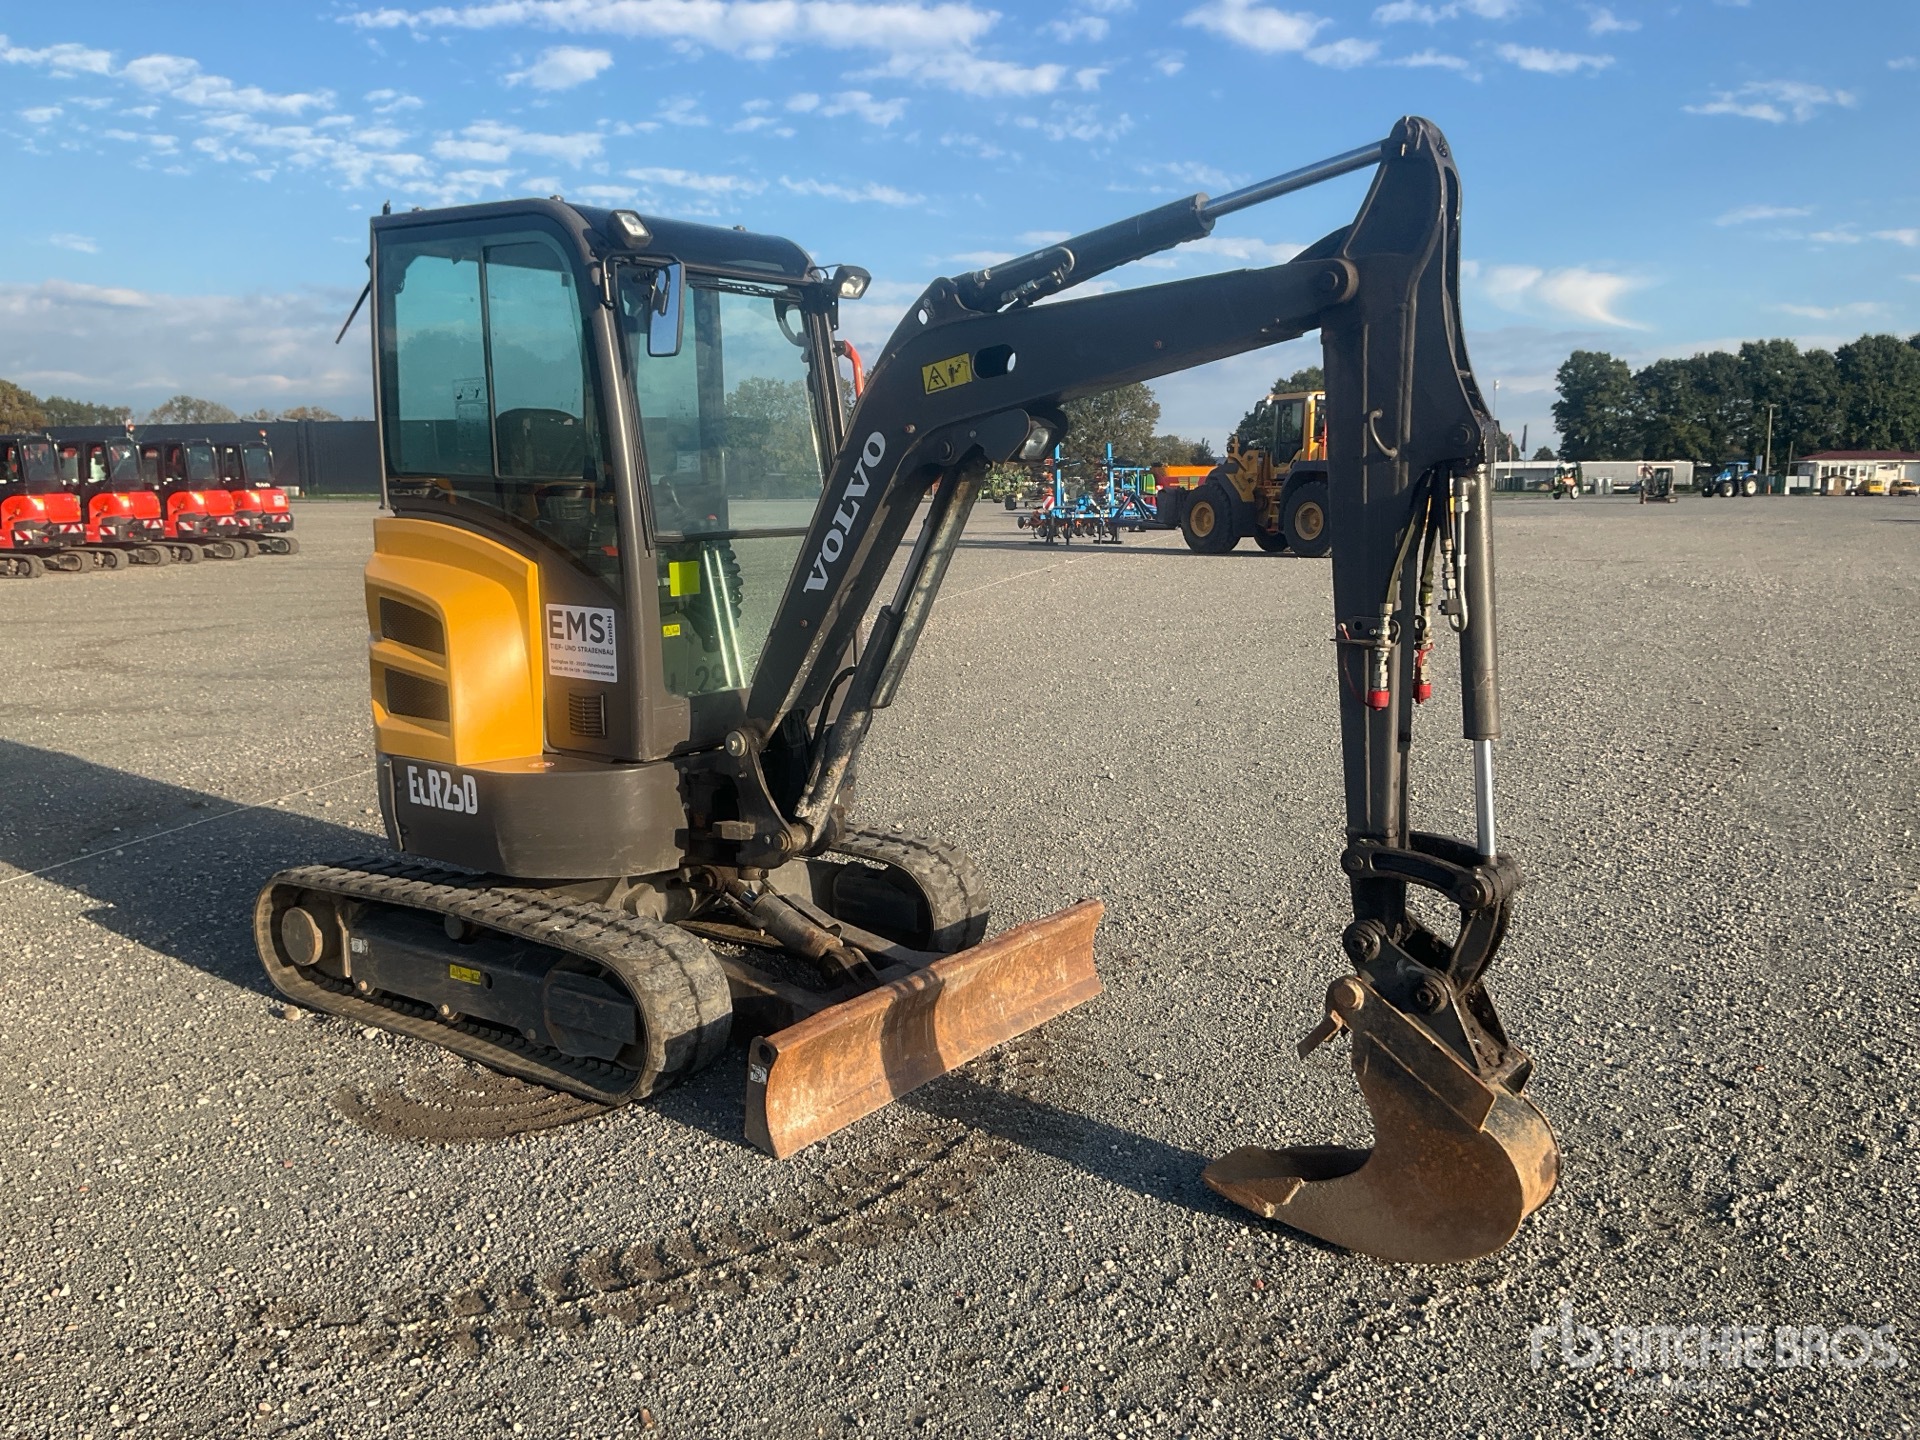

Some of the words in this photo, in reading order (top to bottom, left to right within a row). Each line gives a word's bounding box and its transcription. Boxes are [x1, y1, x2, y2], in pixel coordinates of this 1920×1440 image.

[802, 431, 886, 594] VOLVO
[548, 609, 605, 644] EMS
[606, 615, 614, 645] GmbH
